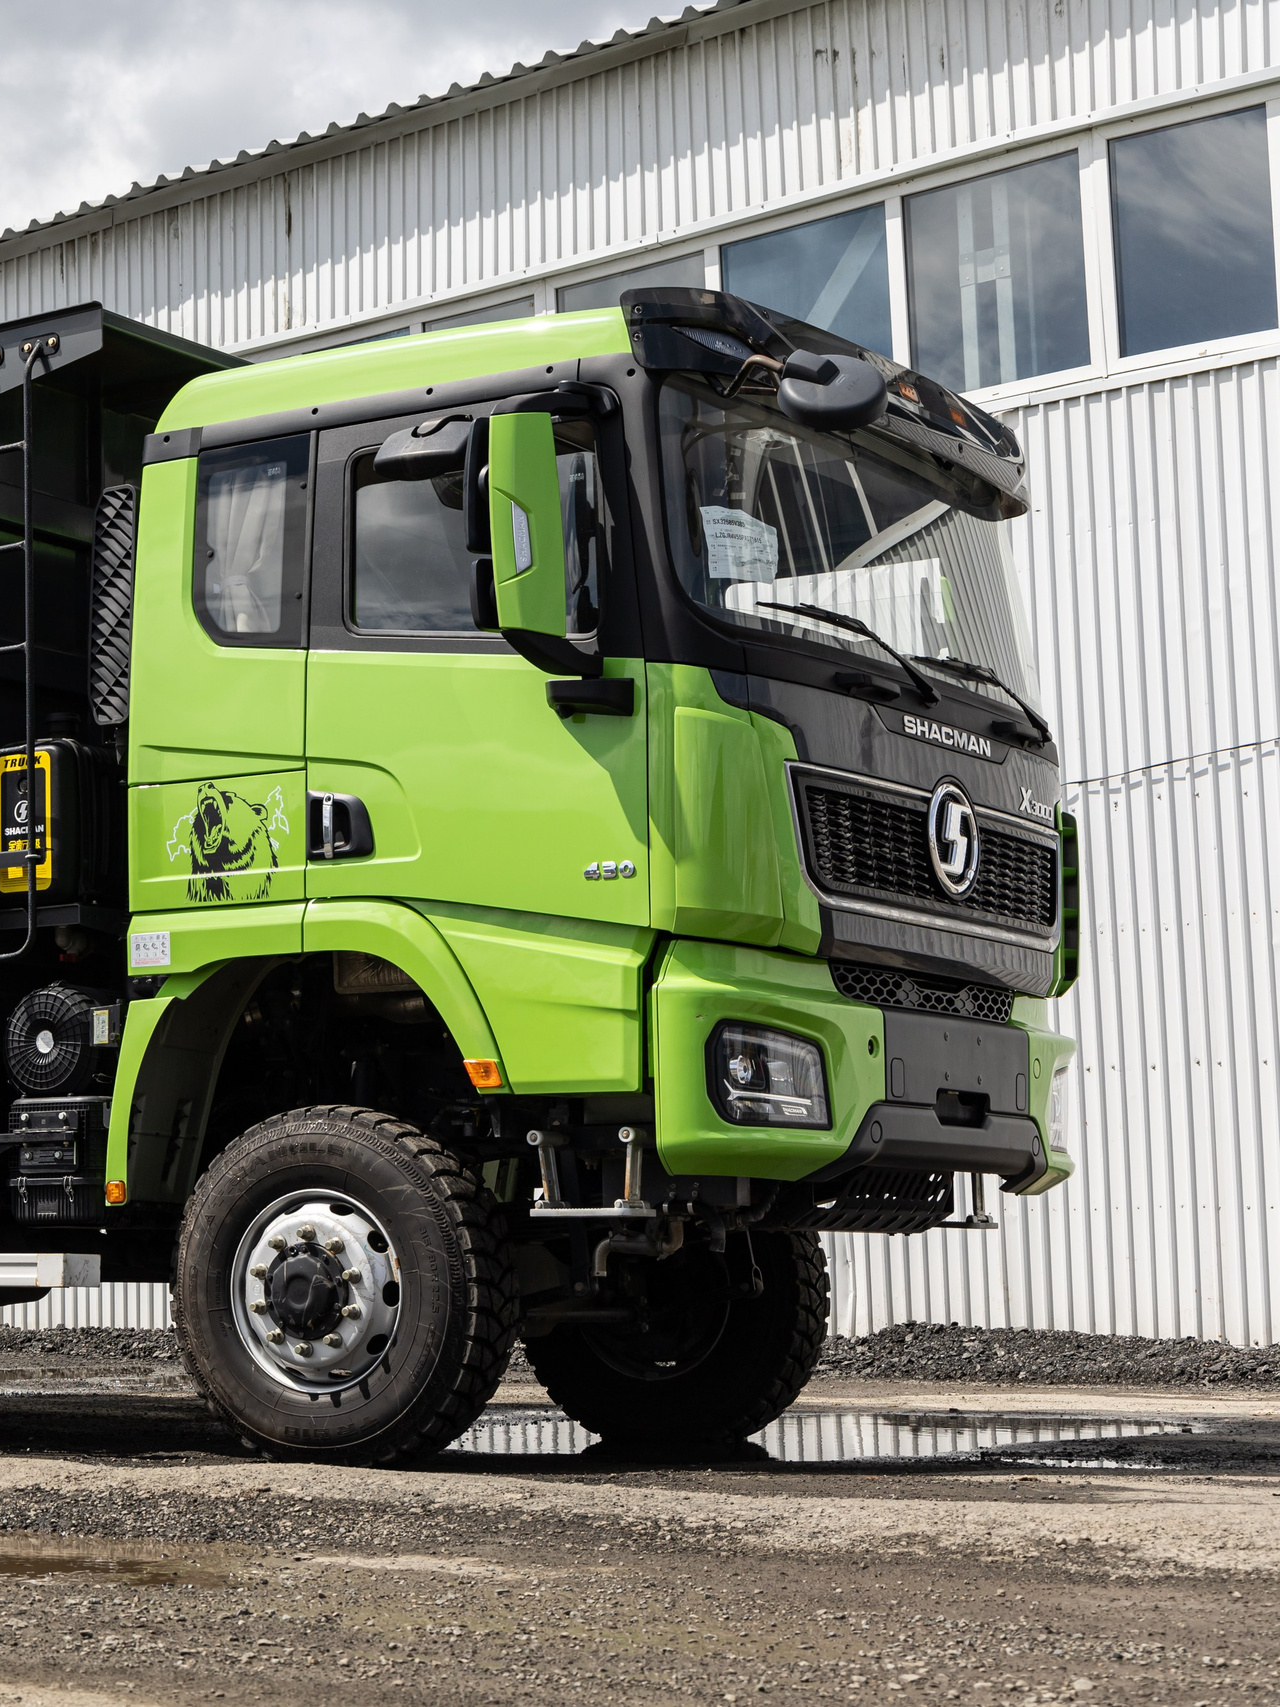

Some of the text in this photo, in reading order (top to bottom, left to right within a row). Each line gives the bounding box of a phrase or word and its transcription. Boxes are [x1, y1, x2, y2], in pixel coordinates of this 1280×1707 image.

[517, 515, 528, 562] SHACMAN
[903, 715, 991, 758] SHACMAN
[4, 755, 42, 768] TRUK
[1019, 786, 1053, 821] X3000
[584, 860, 634, 879] 430
